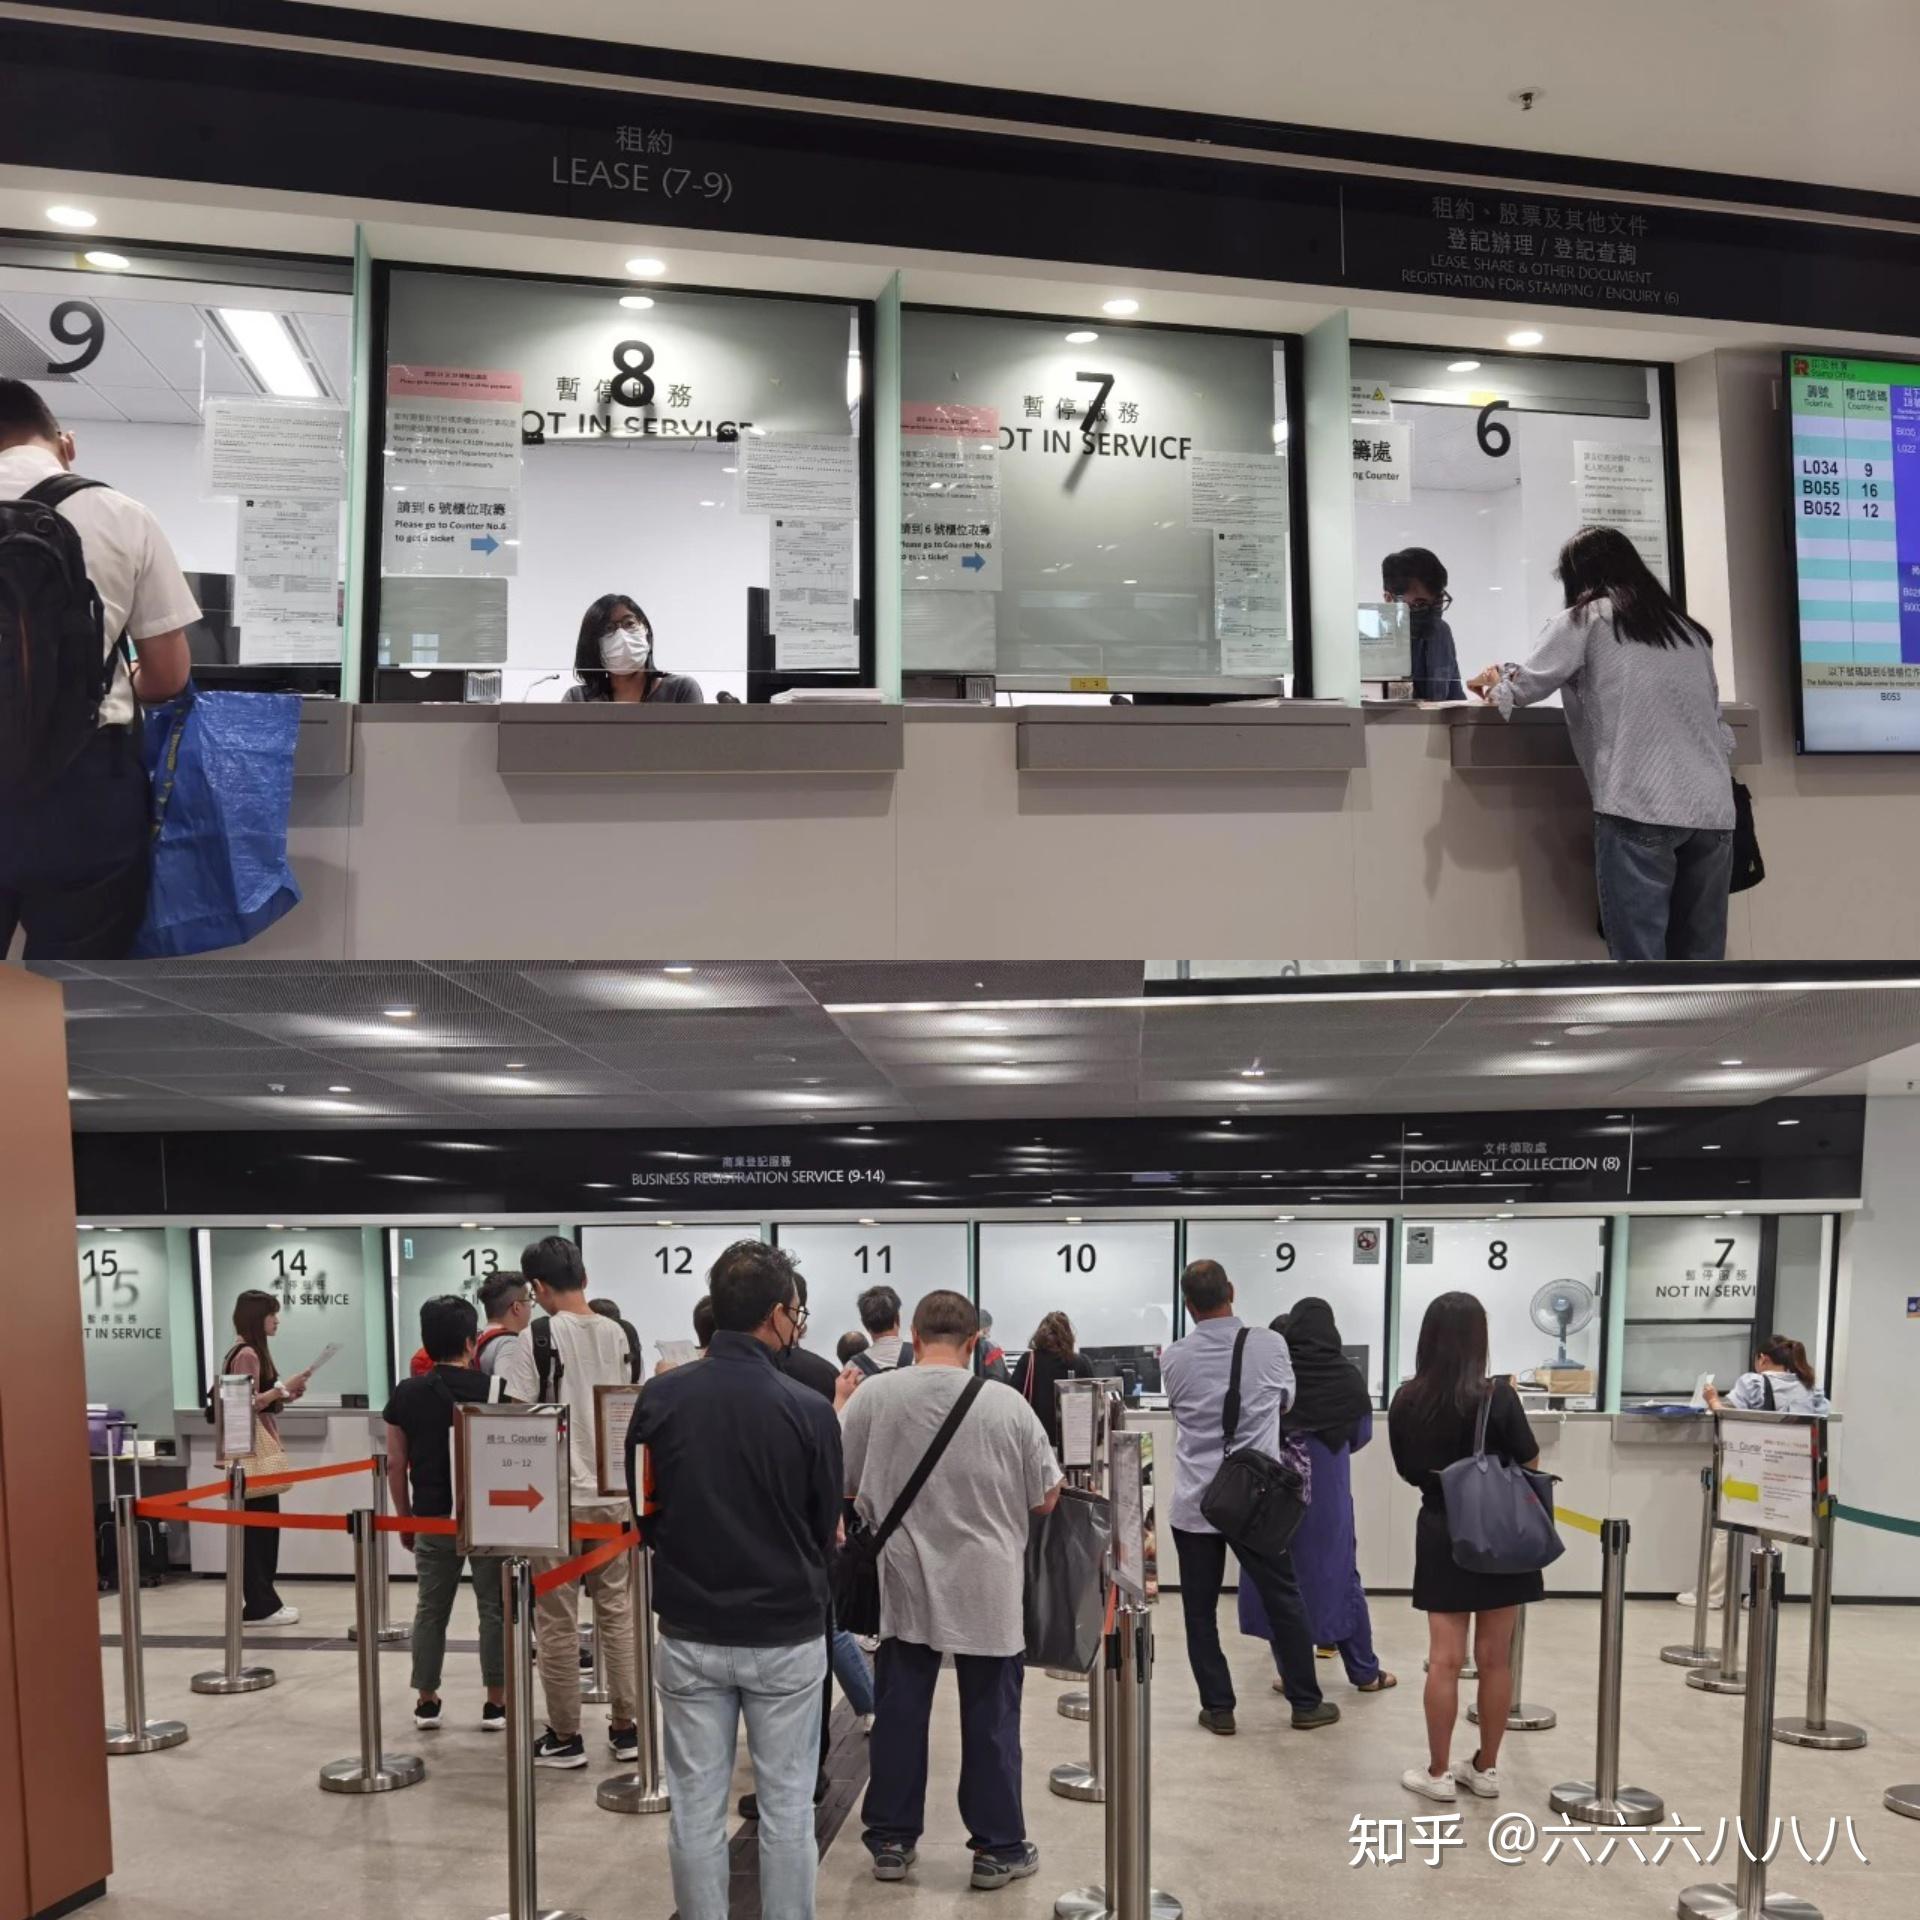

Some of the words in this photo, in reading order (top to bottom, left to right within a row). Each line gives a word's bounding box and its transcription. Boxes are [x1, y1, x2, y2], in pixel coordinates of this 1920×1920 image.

[616, 126, 672, 155] 租約
[553, 157, 649, 192] LEASE
[662, 168, 732, 203] (7-9)
[1474, 258, 1515, 274] SHARE
[1519, 263, 1527, 274] &
[1531, 262, 1575, 279] OTHER
[1579, 268, 1652, 285] DOCUMENT
[1402, 269, 1495, 290] REGISTRATION
[1498, 278, 1525, 293] FOR
[1528, 279, 1594, 299] STAMPING
[1606, 288, 1661, 304] ENQUIRY
[1664, 292, 1680, 306] (6)
[48, 300, 105, 374] 9
[613, 340, 655, 407] 8
[1076, 372, 1115, 433] 7
[522, 410, 567, 435] OT
[579, 413, 611, 434] IN
[1477, 400, 1511, 457] 6
[999, 427, 1032, 451] OT
[1043, 430, 1070, 453] IN
[1366, 471, 1399, 480] Counter
[1803, 460, 1838, 475] L034
[1864, 463, 1873, 477] 9
[1803, 480, 1840, 495] B055
[1862, 483, 1878, 497] 16
[397, 501, 424, 514] 請到
[428, 504, 435, 513] 6
[1804, 501, 1840, 516] B052
[1862, 504, 1879, 518] 12
[395, 520, 425, 529] Please
[426, 522, 436, 530] go
[438, 521, 447, 529] to
[449, 521, 484, 530] Counter
[486, 522, 506, 530] No.6
[395, 534, 404, 542] to
[925, 525, 931, 534] 6
[632, 1172, 690, 1185] BUSINESS
[693, 1170, 788, 1184] REGISTRATION
[792, 1170, 844, 1183] SERVICE
[848, 1169, 885, 1183] (9-14)
[1411, 1159, 1498, 1173] DOCUMENT
[1502, 1157, 1597, 1171] COLLECTION
[1602, 1156, 1620, 1171] (8)
[82, 1249, 118, 1277] 15
[271, 1249, 308, 1276] 14
[462, 1248, 499, 1276] 13
[655, 1246, 692, 1274] 12
[854, 1245, 892, 1273] 11
[1057, 1243, 1096, 1272] 10
[1276, 1242, 1296, 1272] 9
[1488, 1240, 1508, 1270] 8
[1714, 1239, 1735, 1268] 7
[283, 1294, 296, 1305] IN
[300, 1294, 349, 1305] SERVICE
[1656, 1286, 1690, 1298] NOT
[1694, 1286, 1709, 1298] IN
[1714, 1285, 1756, 1298] SERVI
[96, 1328, 108, 1339] IN
[112, 1328, 162, 1339] SERVICE
[511, 1433, 547, 1443] Counter
